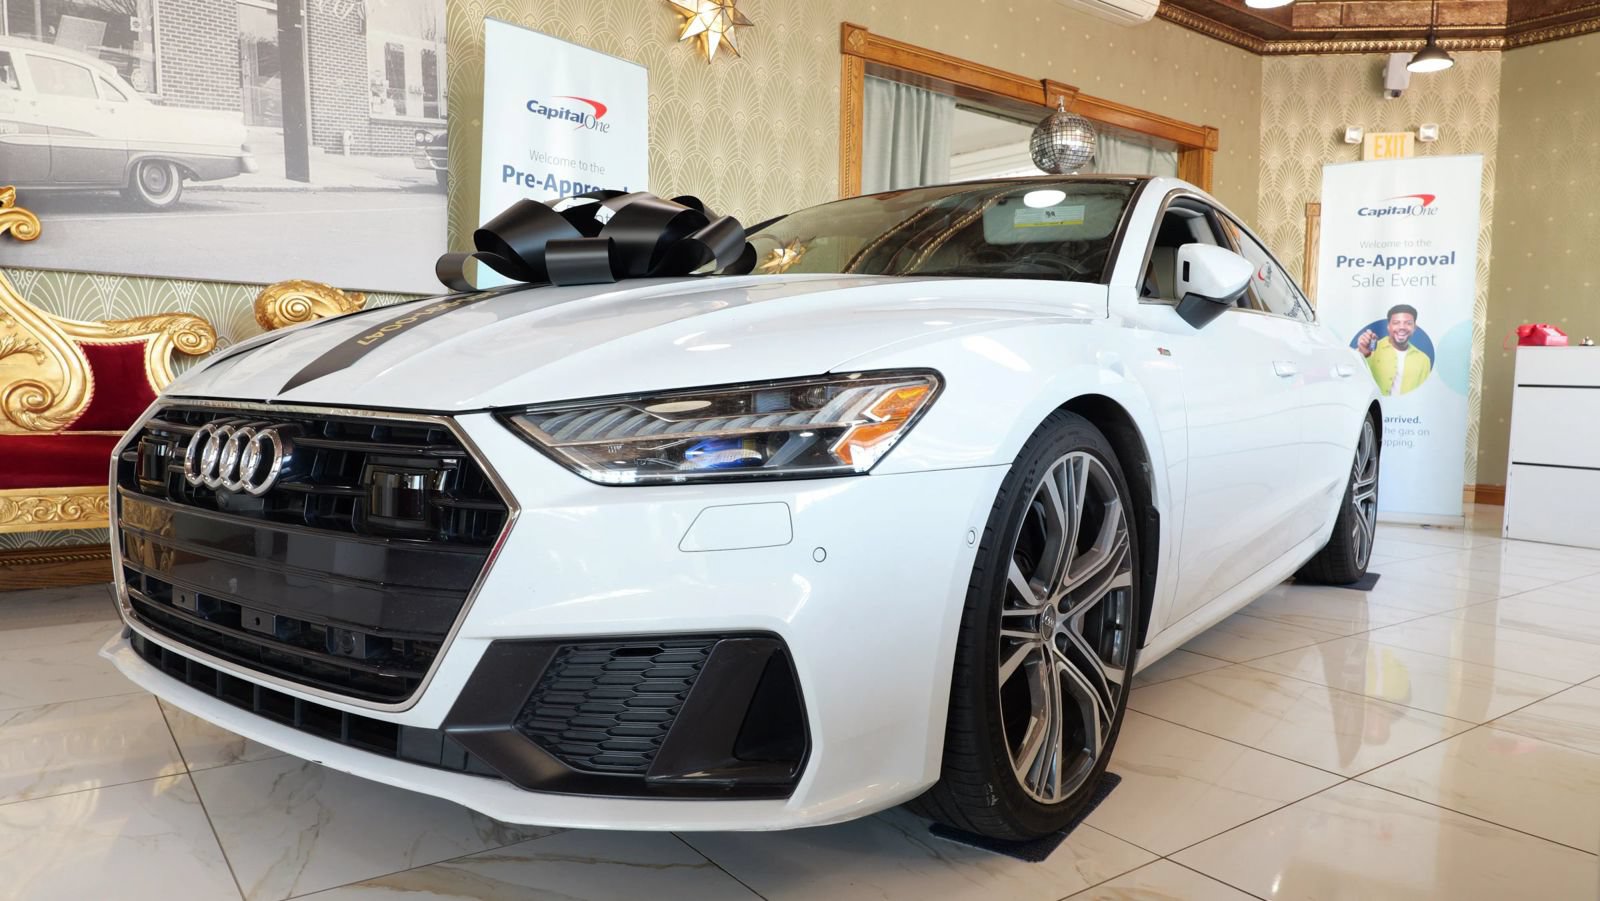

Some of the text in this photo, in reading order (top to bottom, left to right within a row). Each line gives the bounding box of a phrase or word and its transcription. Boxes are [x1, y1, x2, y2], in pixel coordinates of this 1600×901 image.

[1374, 134, 1406, 160] EXIT
[529, 149, 606, 175] Welcome to the
[1359, 239, 1432, 250] Welcome to the
[1336, 251, 1455, 270] Pre-Approval
[1352, 273, 1437, 288] Sale Event
[1384, 415, 1422, 425] arrived.
[1398, 427, 1415, 437] gas
[1417, 429, 1430, 437] on
